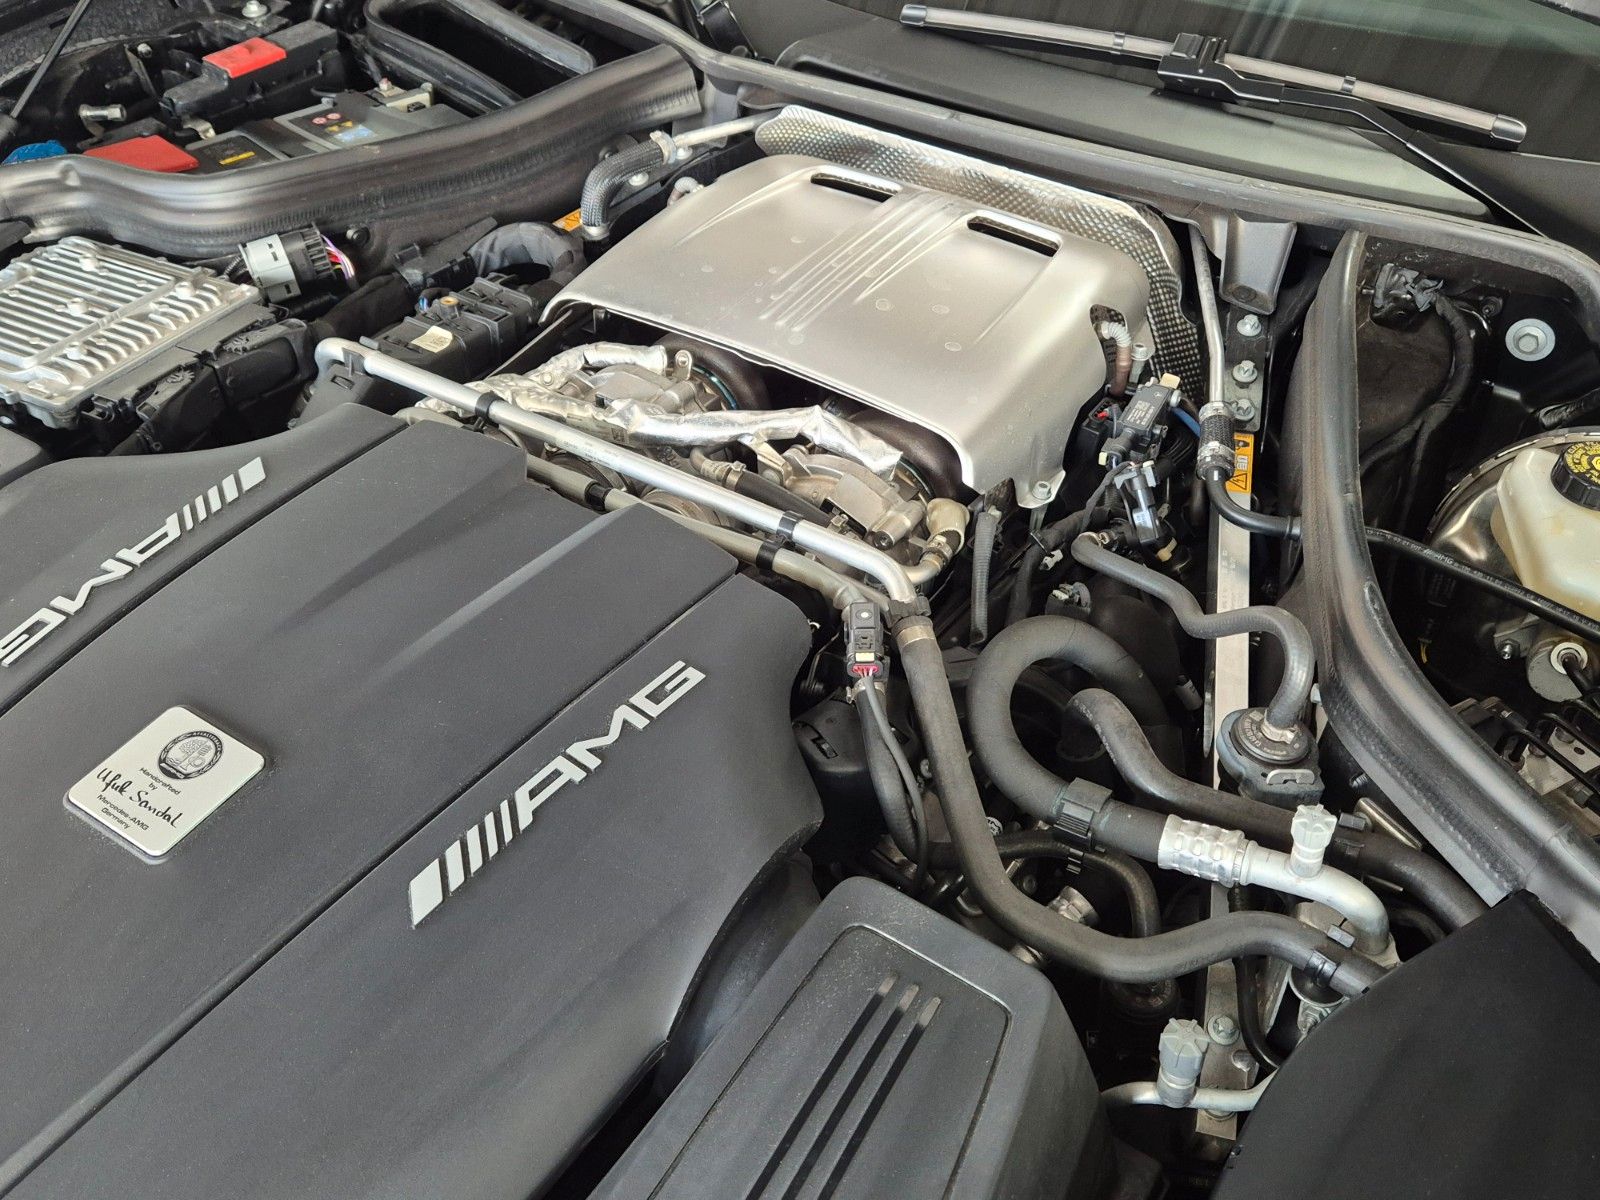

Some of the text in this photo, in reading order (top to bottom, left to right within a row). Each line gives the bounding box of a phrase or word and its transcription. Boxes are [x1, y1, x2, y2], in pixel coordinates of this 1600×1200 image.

[0, 512, 182, 667] AMG
[514, 660, 706, 834] AMG
[139, 767, 182, 795] Handcrafted
[148, 782, 158, 791] by
[96, 794, 149, 831] Mercedes-AMG
[101, 807, 130, 830] Germany
[129, 790, 183, 828] Sandal
